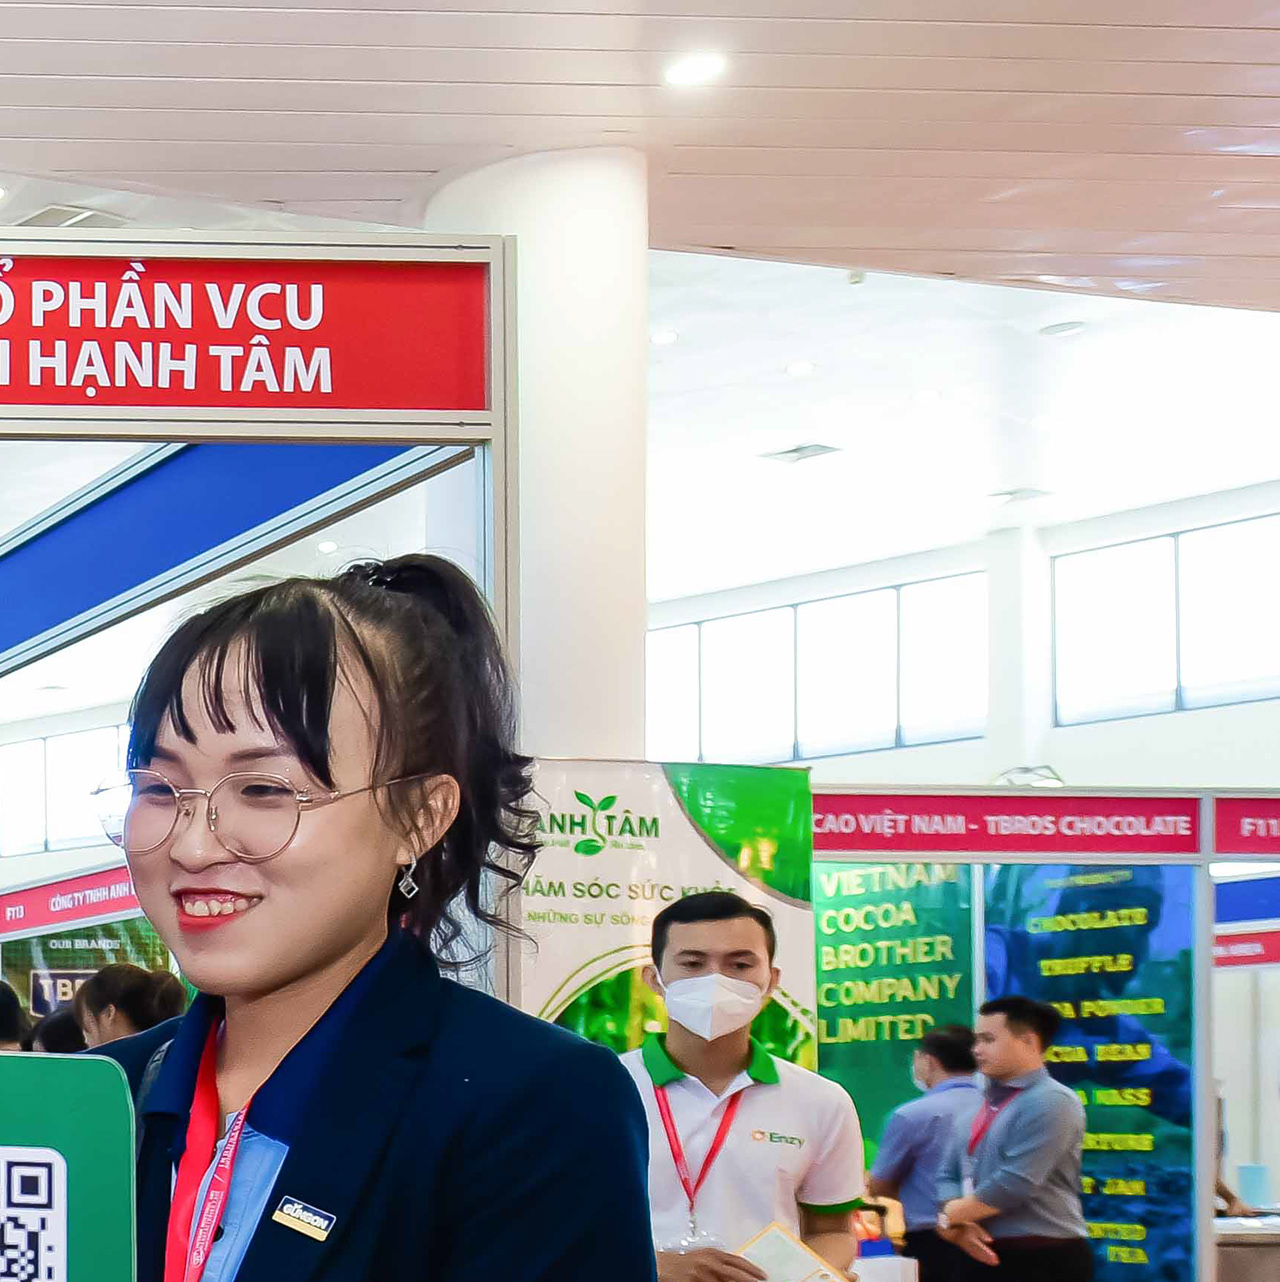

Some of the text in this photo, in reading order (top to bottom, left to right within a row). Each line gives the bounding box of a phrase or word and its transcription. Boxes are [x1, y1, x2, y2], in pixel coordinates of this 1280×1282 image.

[31, 262, 193, 329] PHẦN
[205, 282, 324, 331] VCU
[28, 338, 197, 398] HẠNH
[209, 333, 334, 394] TÂM
[604, 809, 660, 838] TÂM
[858, 808, 909, 837] VIỆT
[912, 814, 966, 834] NAM
[1058, 815, 1192, 836] CHOCOLATE
[572, 877, 620, 899] SÓC
[628, 879, 674, 901] SỨC
[821, 862, 956, 897] VIETNAM
[820, 901, 917, 935] COCOA
[820, 935, 955, 971] BROTHER
[818, 973, 962, 1007] COMPANY
